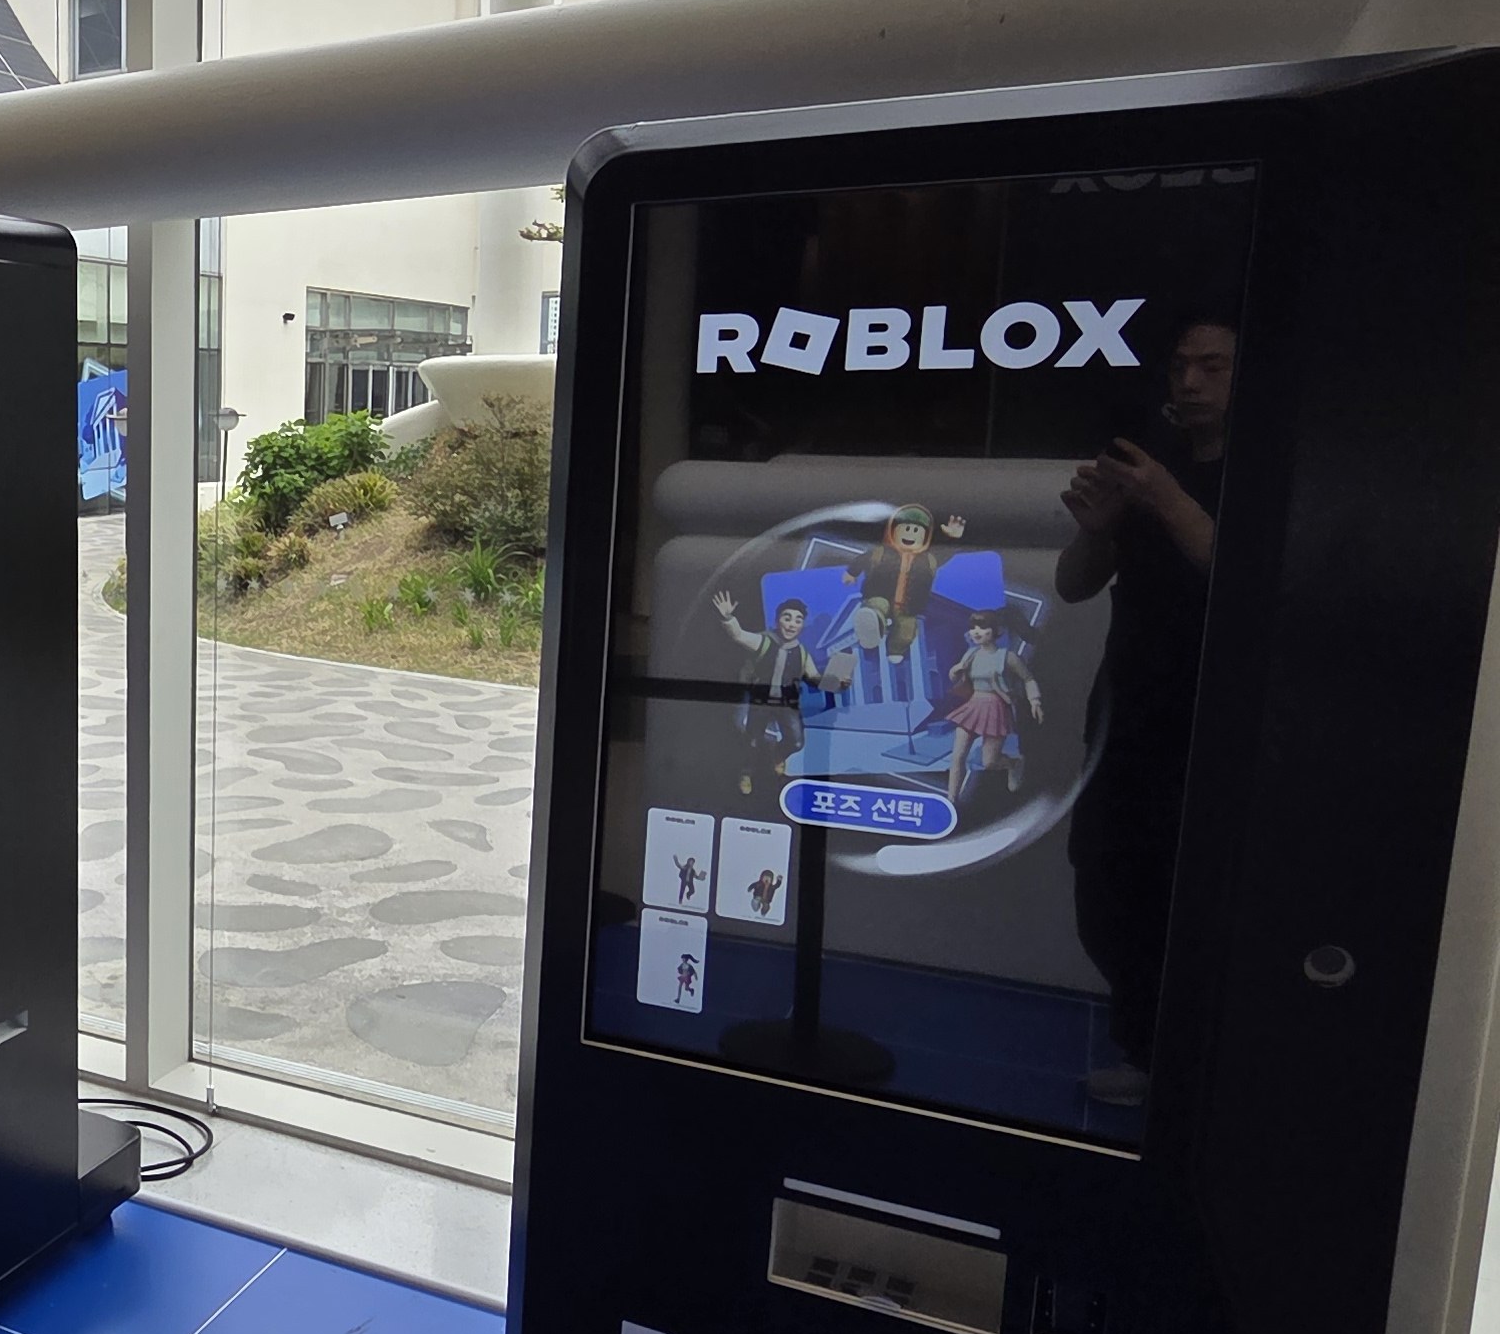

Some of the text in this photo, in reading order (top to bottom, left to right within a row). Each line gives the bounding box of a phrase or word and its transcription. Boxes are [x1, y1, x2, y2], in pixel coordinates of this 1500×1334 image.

[696, 298, 1146, 375] ROBLOX
[810, 791, 924, 827] 포즈 선택
